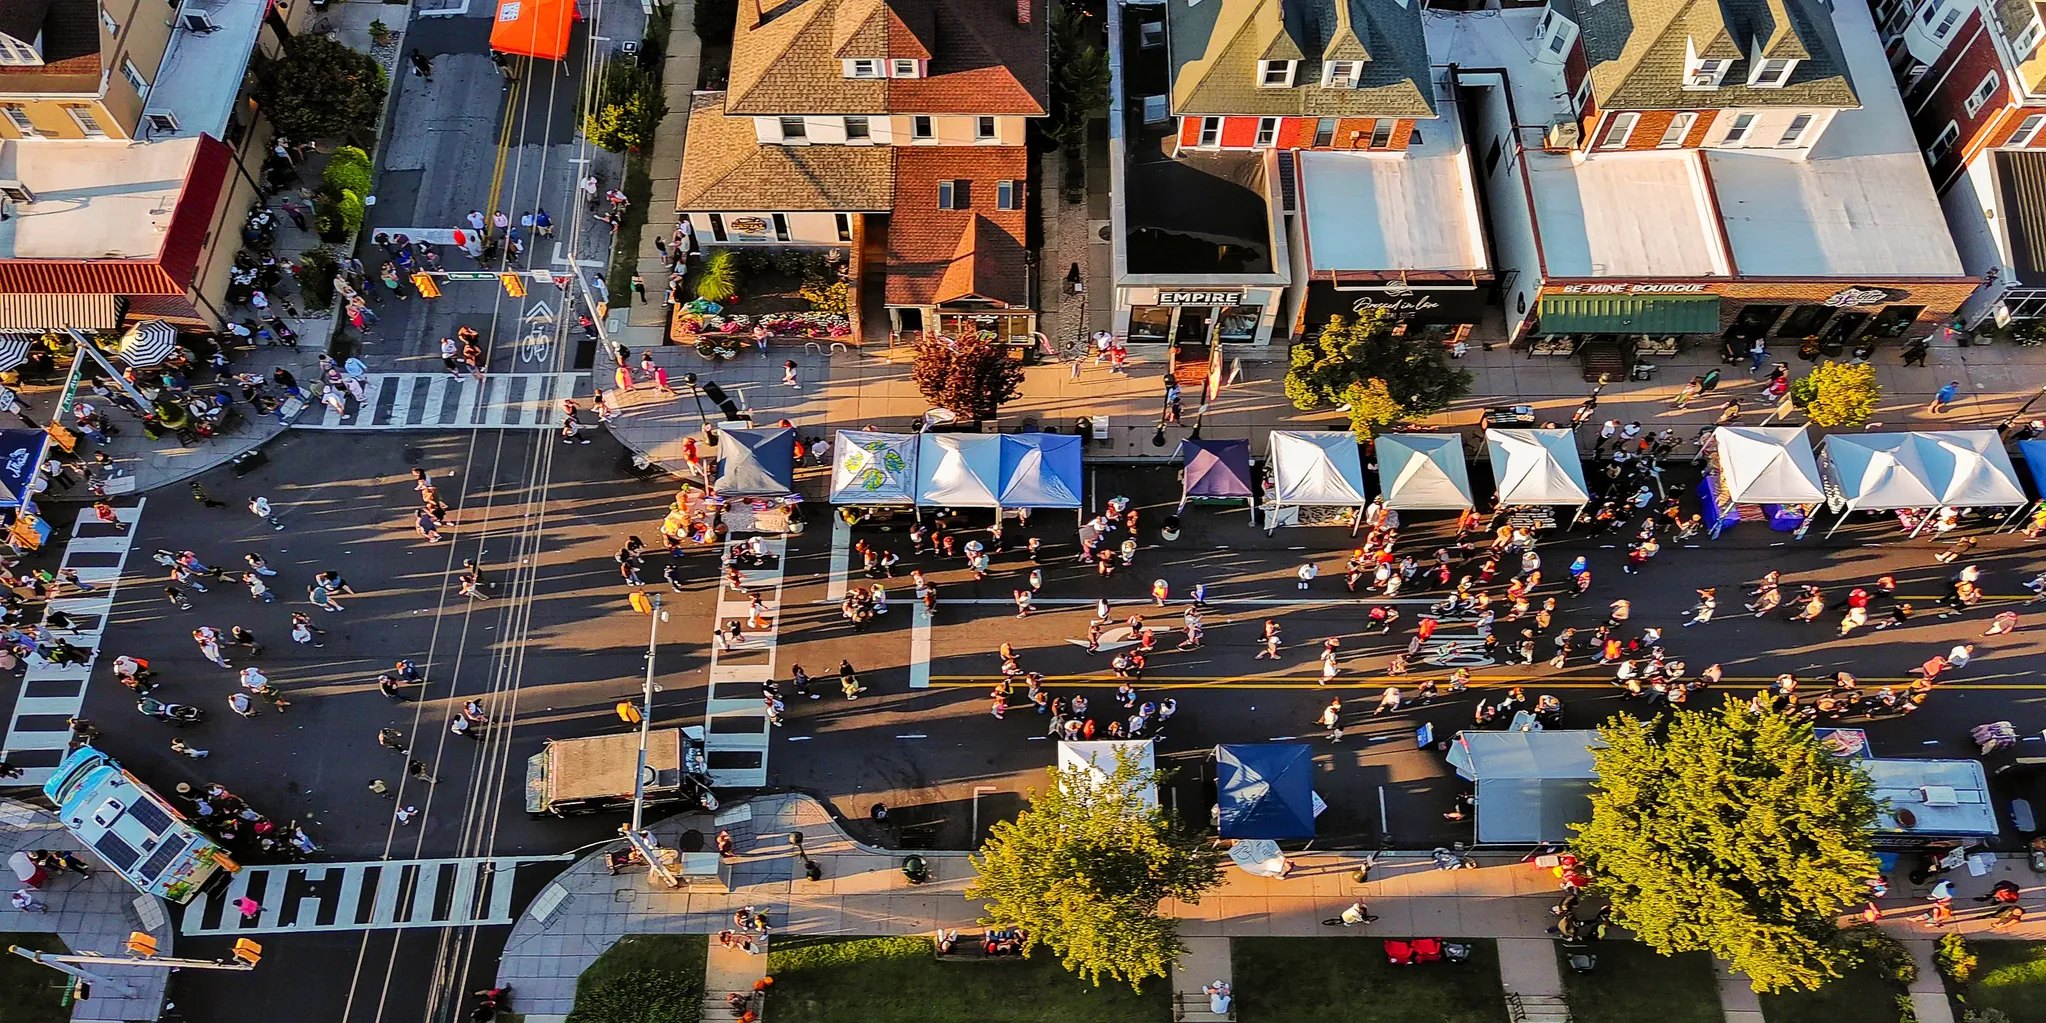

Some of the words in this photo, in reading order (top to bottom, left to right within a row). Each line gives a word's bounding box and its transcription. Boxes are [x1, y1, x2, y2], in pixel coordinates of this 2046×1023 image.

[1563, 284, 1583, 293] BE
[1586, 284, 1627, 293] MINE
[1631, 284, 1706, 292] BOUTIQUE
[1160, 293, 1239, 303] EMPIRE
[1400, 301, 1415, 310] in
